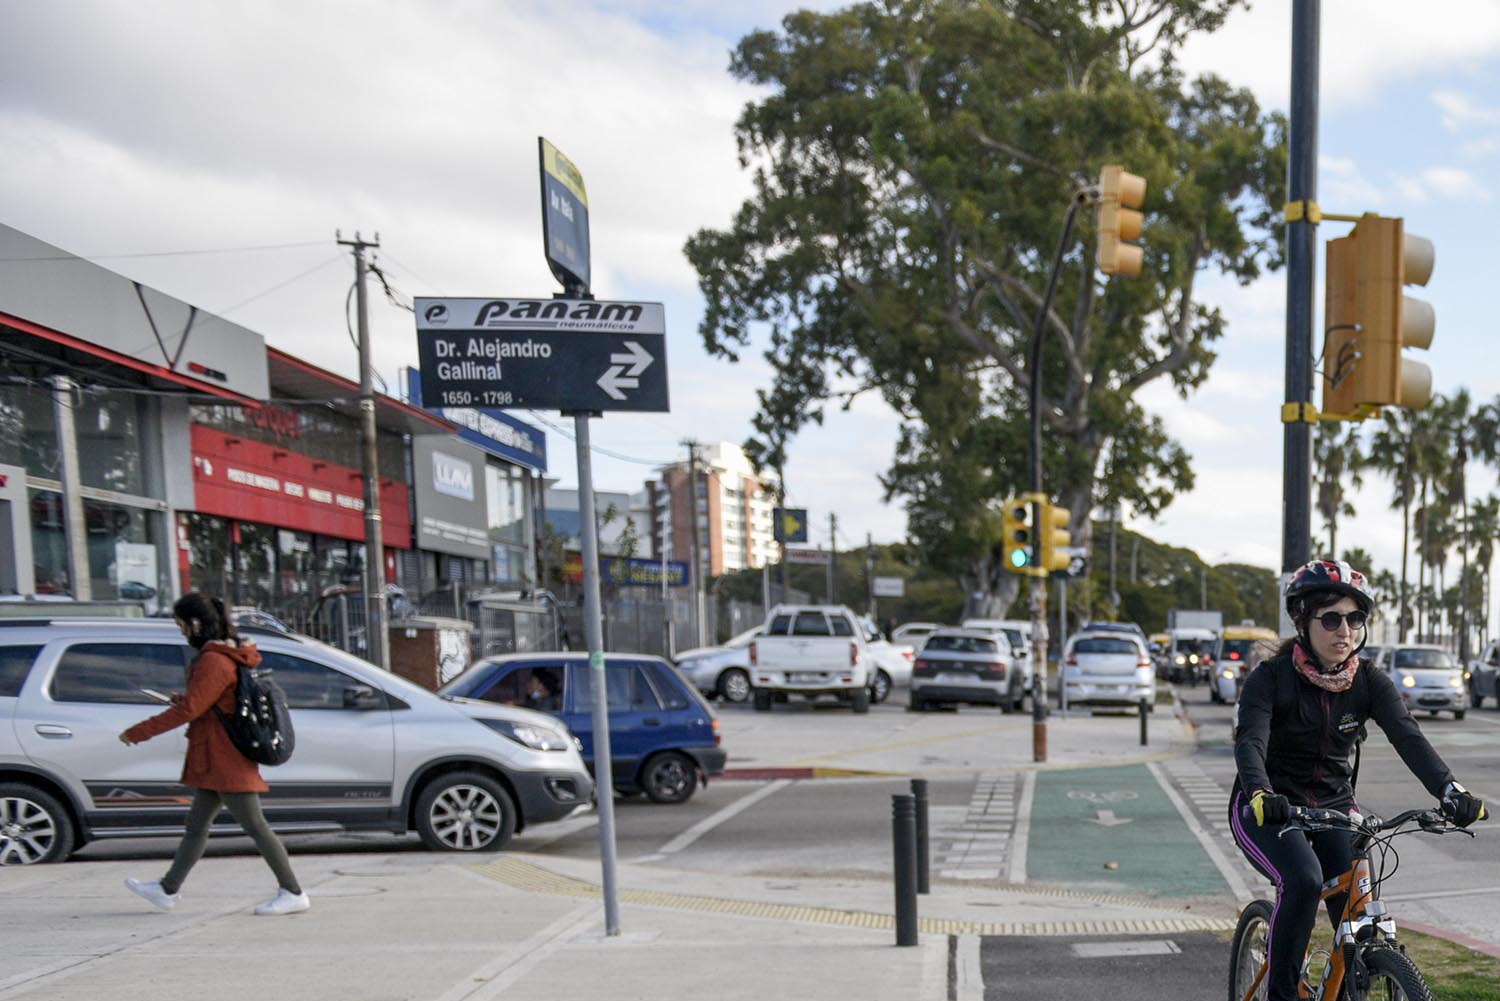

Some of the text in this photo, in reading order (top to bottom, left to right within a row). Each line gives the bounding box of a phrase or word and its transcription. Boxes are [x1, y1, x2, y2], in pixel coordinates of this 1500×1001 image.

[474, 300, 643, 327] panam
[436, 338, 552, 361] Dr. Alejandro
[438, 362, 502, 381] Gallinal
[442, 391, 472, 405] 1650
[483, 391, 513, 405] 1798
